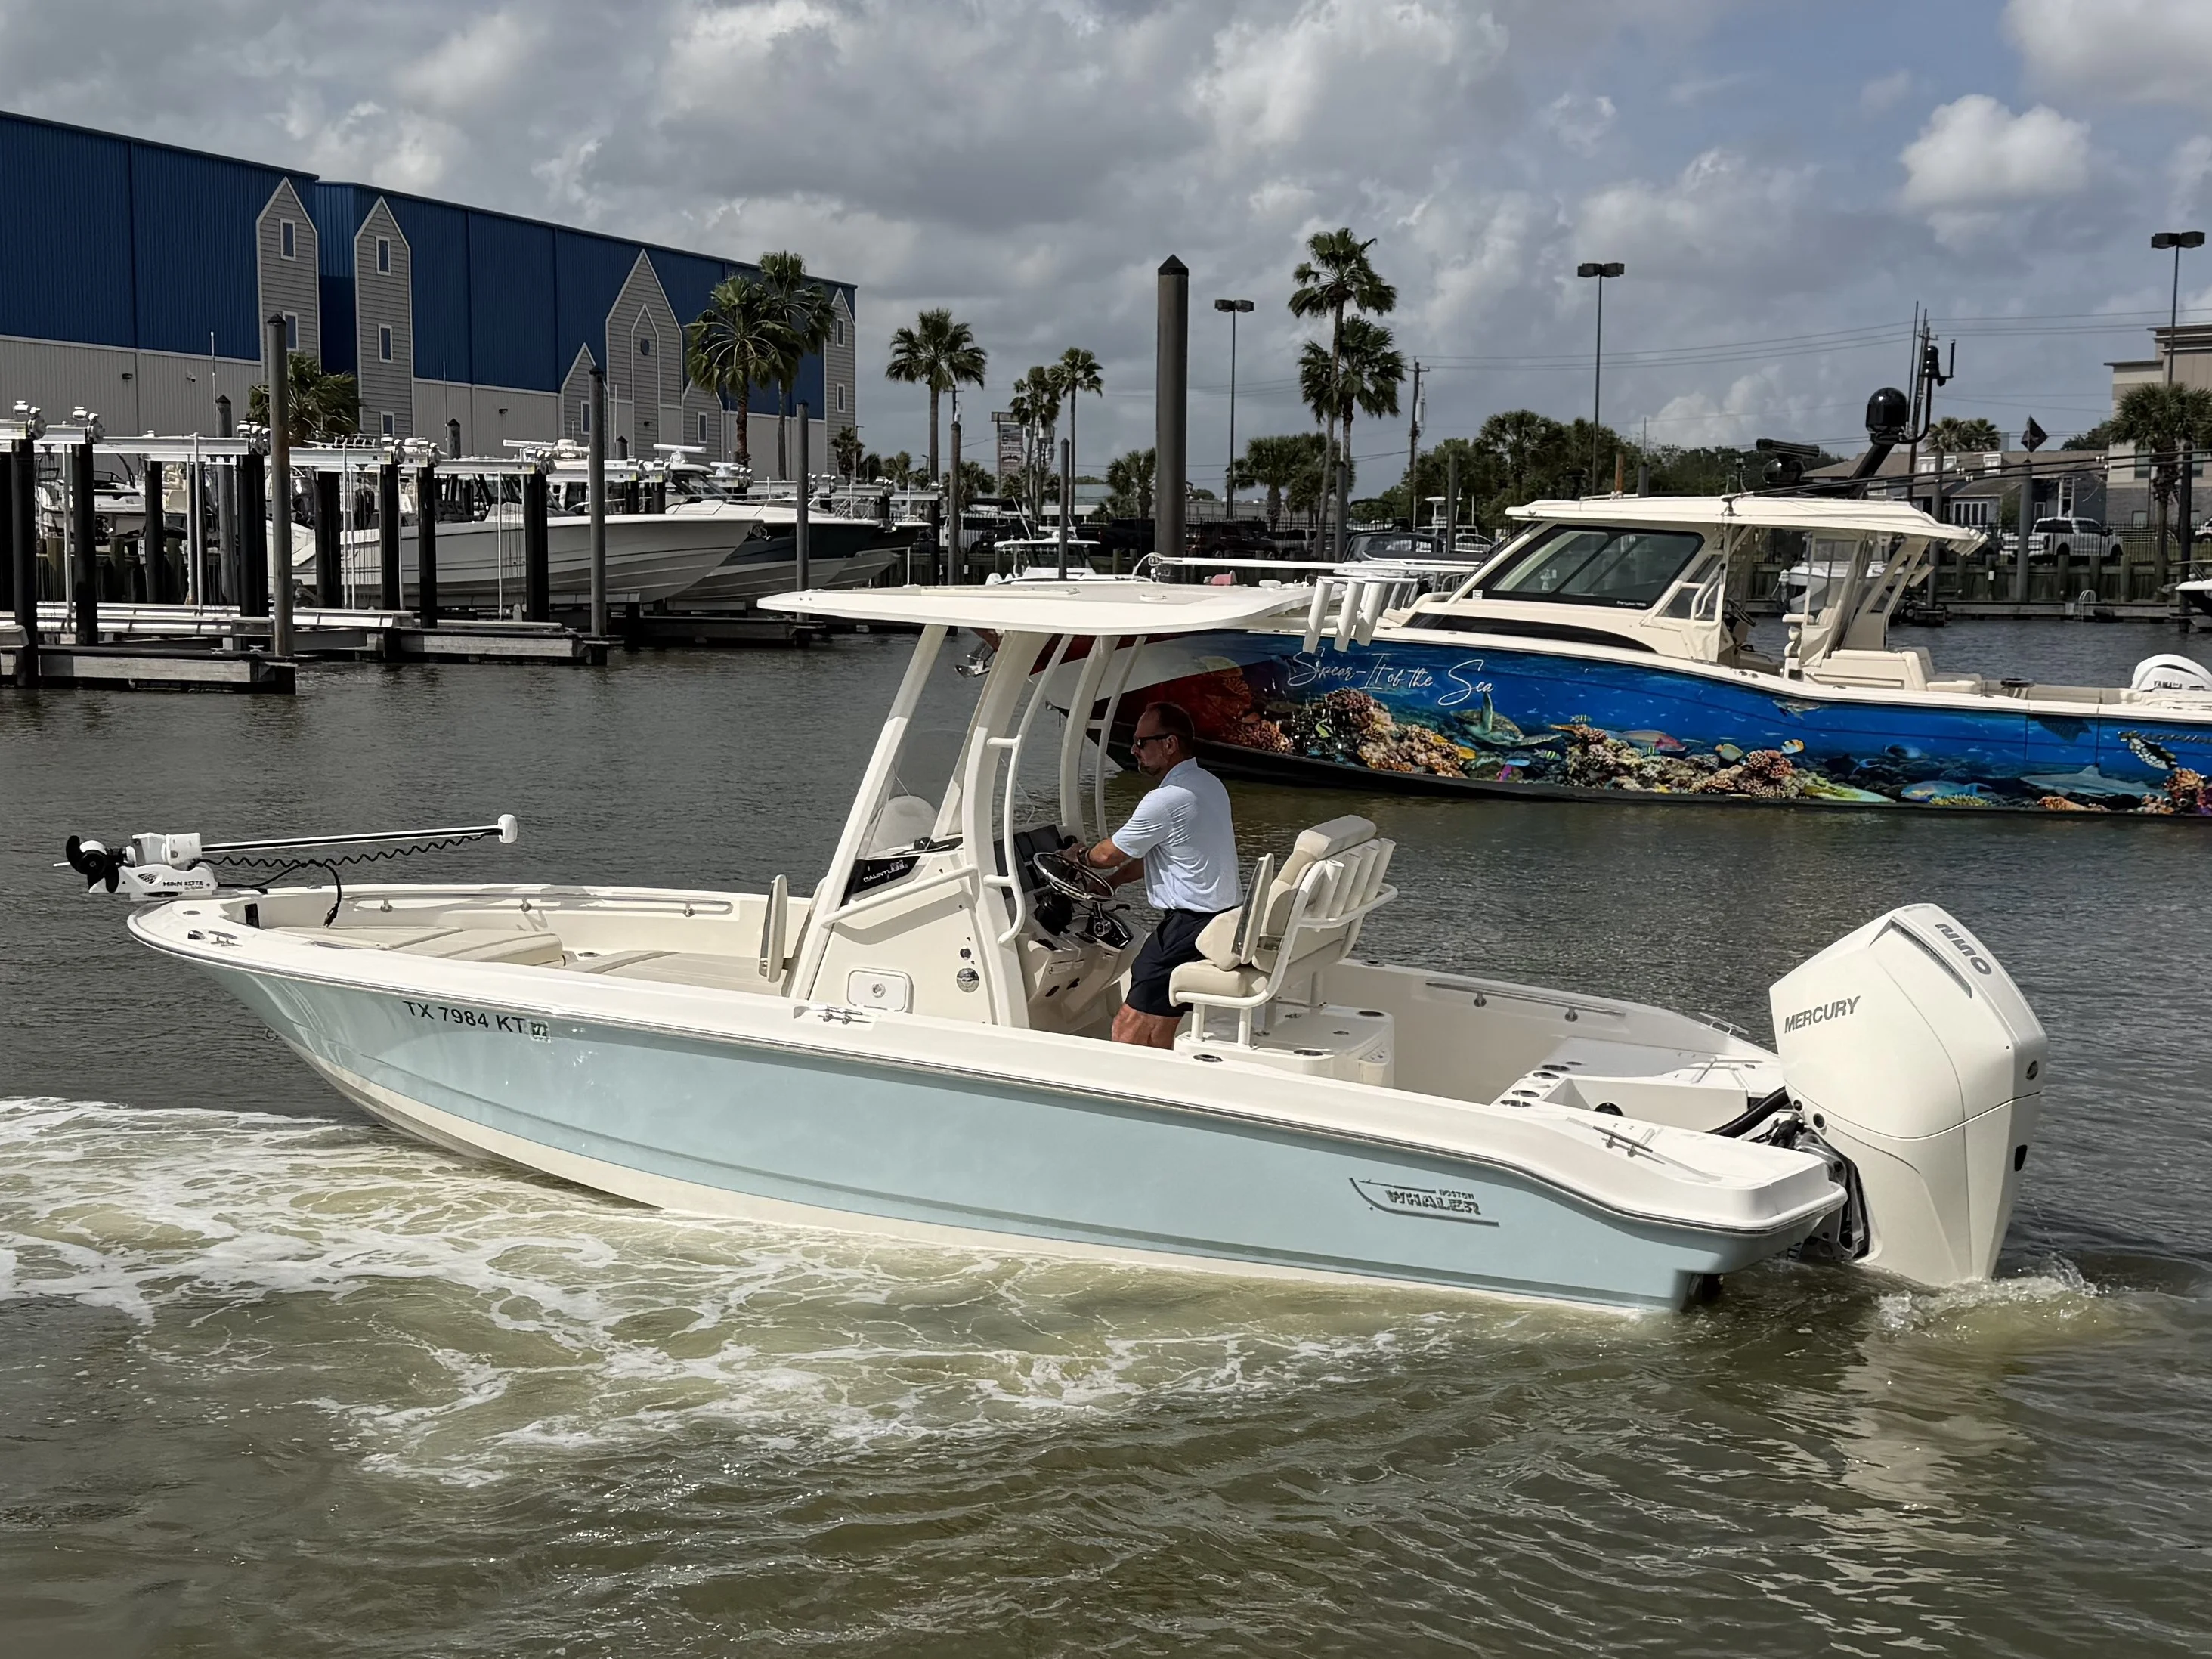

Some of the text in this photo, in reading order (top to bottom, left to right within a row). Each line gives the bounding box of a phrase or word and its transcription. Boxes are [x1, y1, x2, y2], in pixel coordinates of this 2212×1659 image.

[1388, 668, 1405, 688] of
[1403, 667, 1434, 689] the
[1438, 659, 1494, 706] Sea
[402, 1001, 434, 1020] TX
[438, 1006, 489, 1028] 7984
[496, 1014, 527, 1033] KT
[1784, 995, 1861, 1034] MERCURY
[1385, 1190, 1481, 1215] WHALER
[1439, 1189, 1474, 1199] BOSTON
